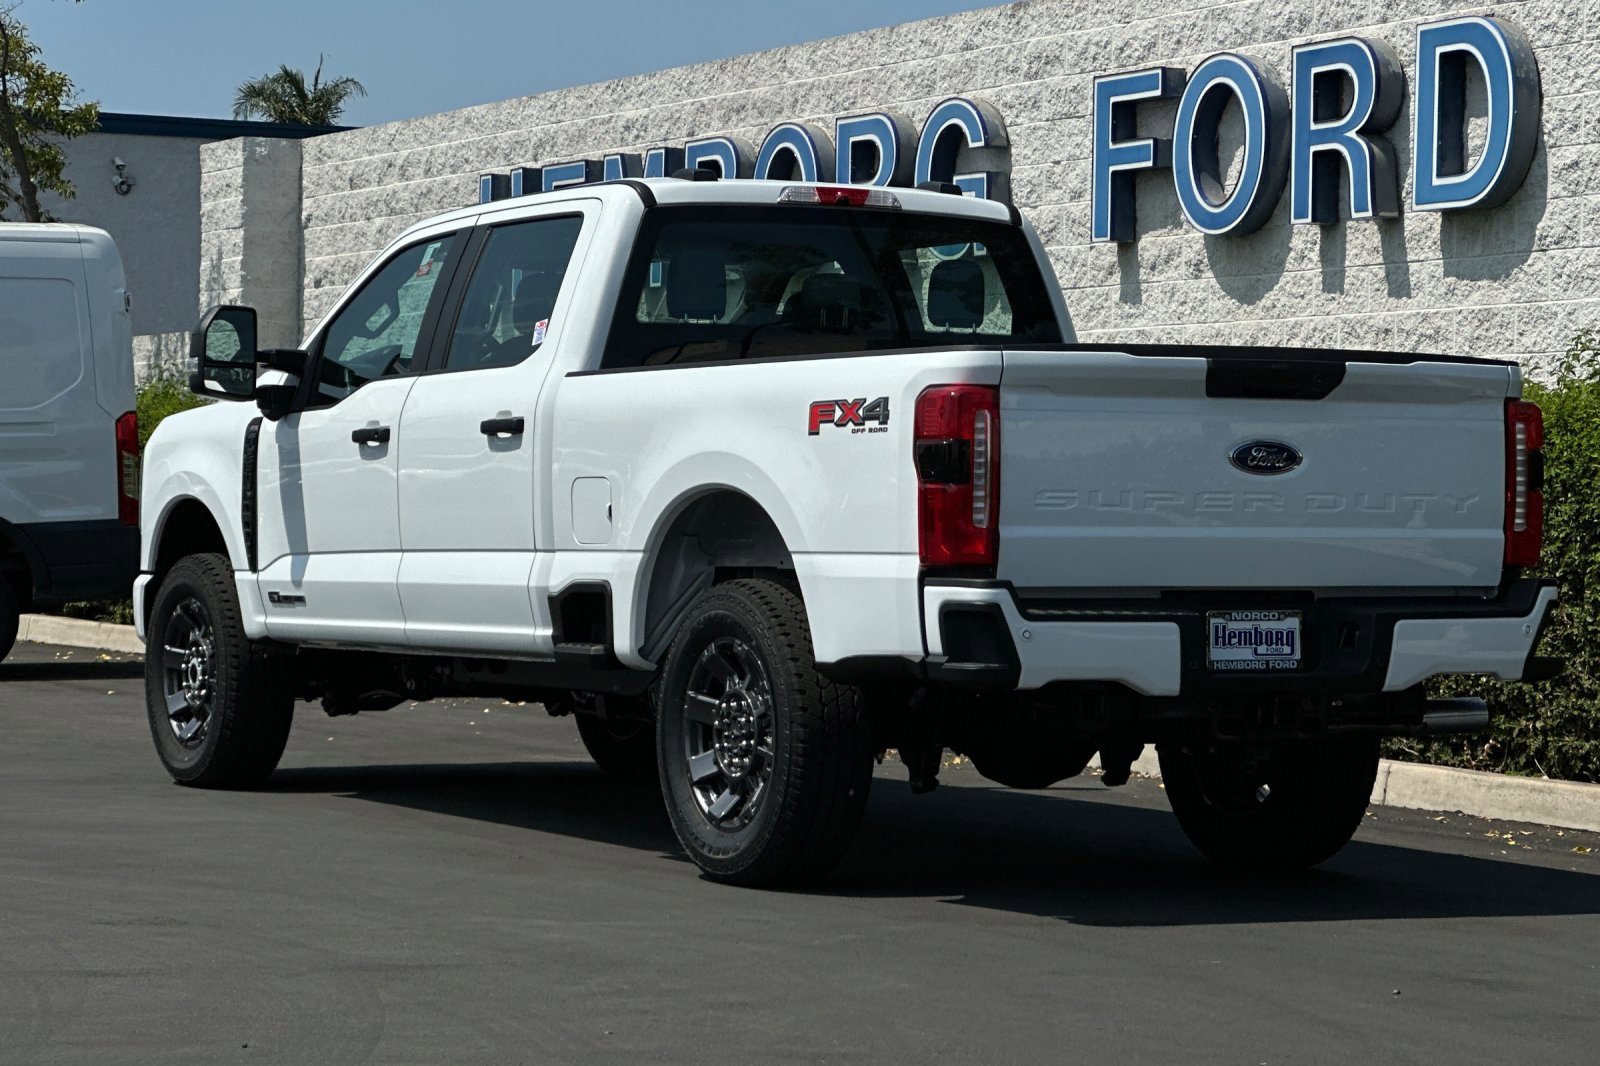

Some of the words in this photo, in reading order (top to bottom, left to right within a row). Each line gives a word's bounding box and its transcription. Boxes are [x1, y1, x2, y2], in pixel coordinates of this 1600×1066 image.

[1091, 15, 1516, 243] FORD
[808, 396, 890, 436] FX4
[851, 427, 867, 435] OFF
[868, 426, 888, 434] ROAD
[1247, 446, 1288, 467] Ford
[1034, 489, 1285, 512] SUPER
[1305, 492, 1480, 513] DUTY
[1231, 612, 1279, 621] NORCO
[1213, 623, 1296, 657] Hemborg
[1266, 646, 1284, 654] FORD
[1213, 660, 1267, 670] HEMBORG
[1269, 660, 1298, 669] FORD
